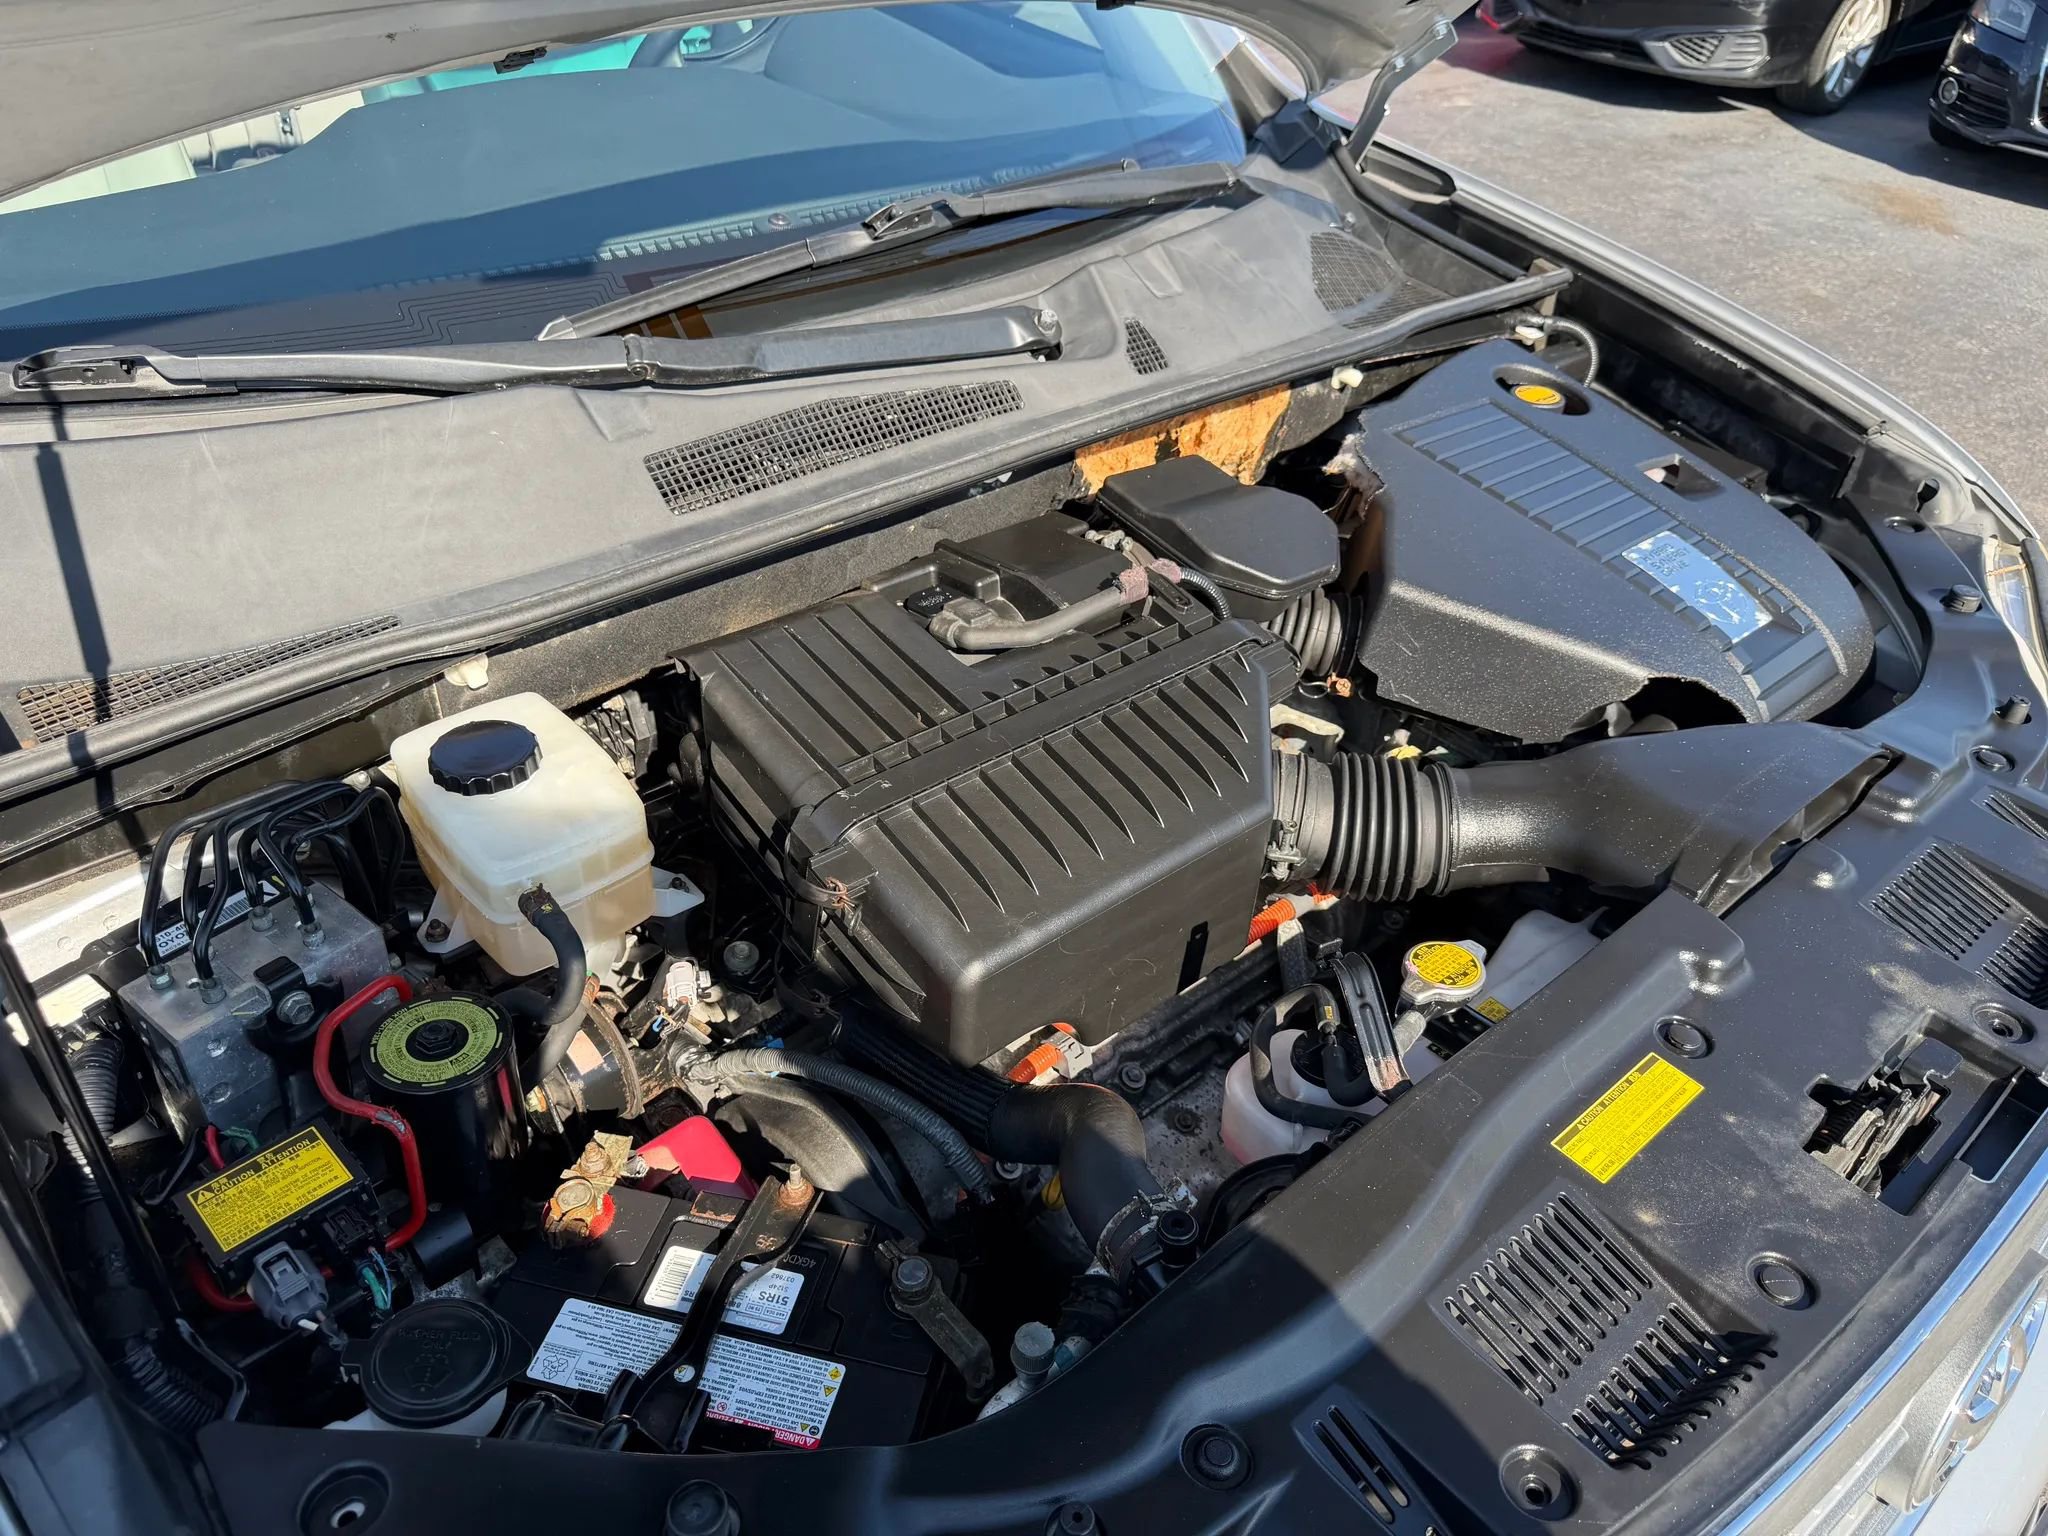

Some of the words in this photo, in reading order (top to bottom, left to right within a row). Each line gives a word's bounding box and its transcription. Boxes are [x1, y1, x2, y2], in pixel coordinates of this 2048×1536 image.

[1579, 1104, 1604, 1125] CAUTION
[1601, 1081, 1629, 1105] ATTENTION
[212, 1168, 255, 1195] CAUTION
[259, 1138, 311, 1170] ATTENTION
[756, 1290, 790, 1306] 51RS
